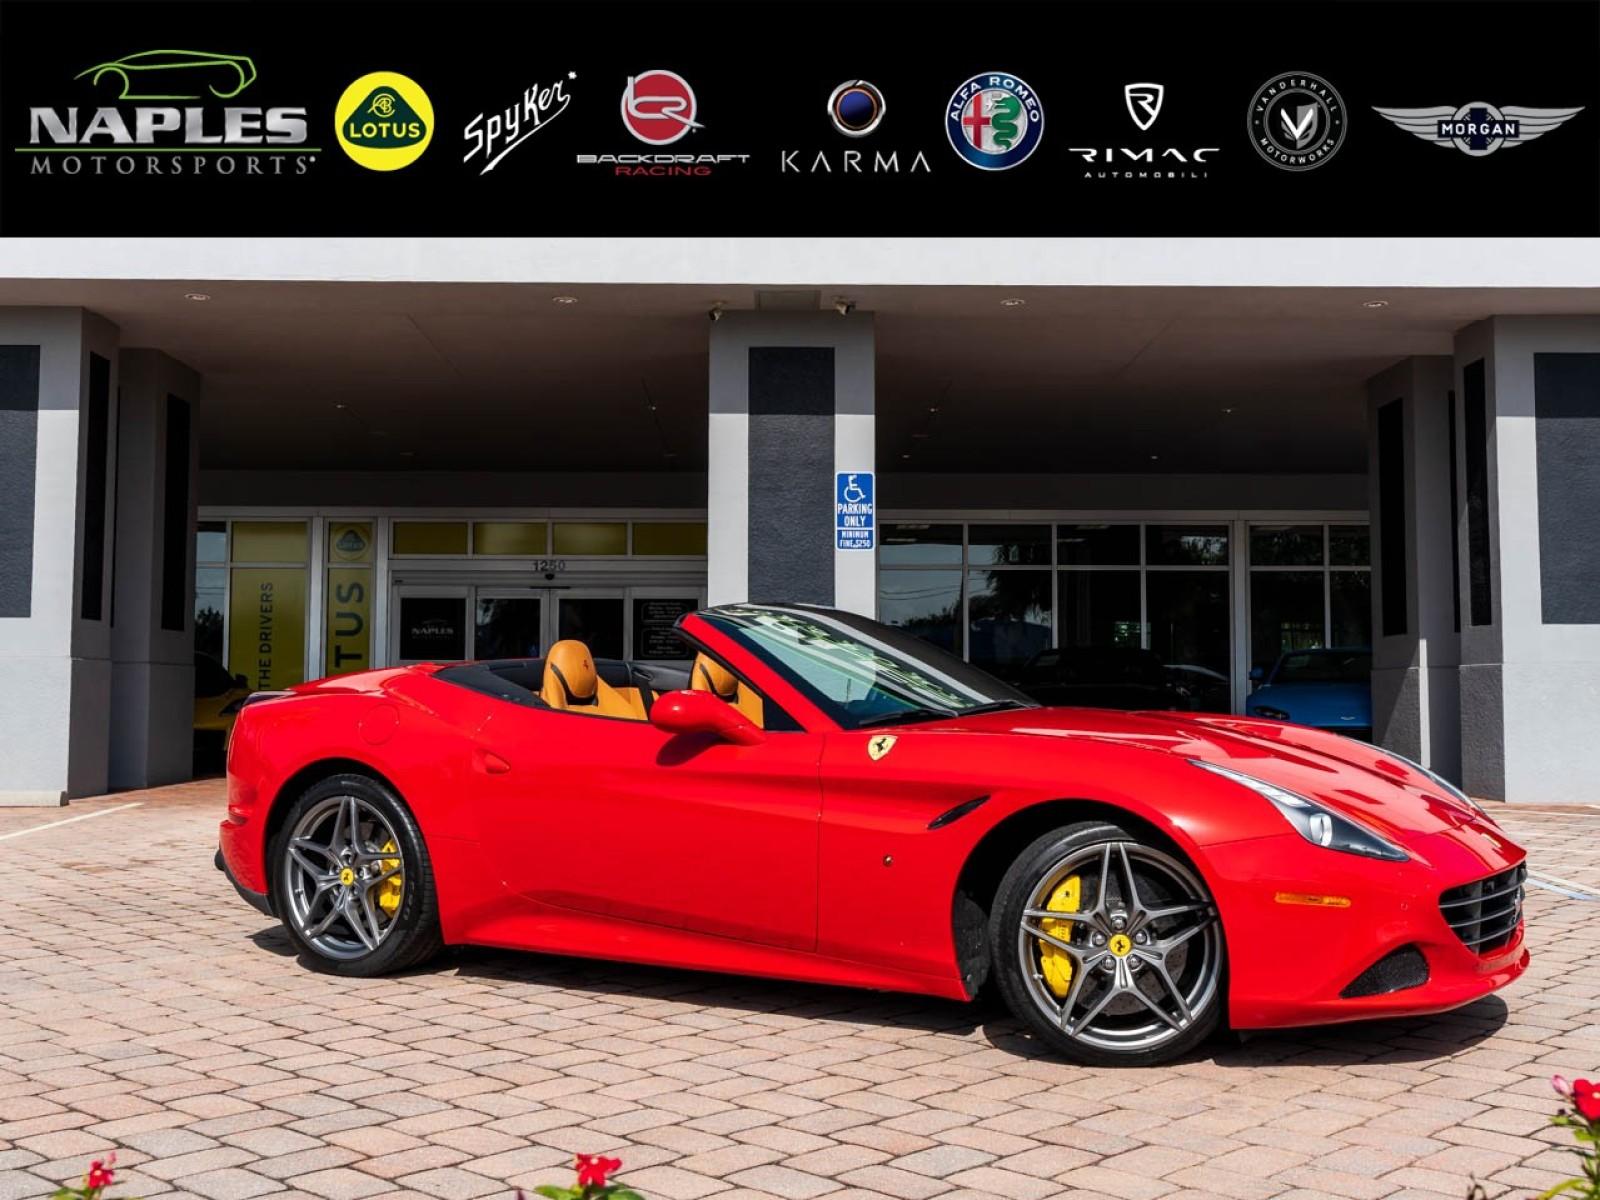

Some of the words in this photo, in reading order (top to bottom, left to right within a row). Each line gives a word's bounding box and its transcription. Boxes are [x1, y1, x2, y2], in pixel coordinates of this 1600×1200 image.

[837, 503, 873, 514] PARKING
[844, 515, 866, 527] ONLY
[841, 530, 869, 539] MINIMUM
[533, 560, 566, 572] 1250
[258, 581, 274, 654] DRIVERS
[258, 656, 273, 690] THE
